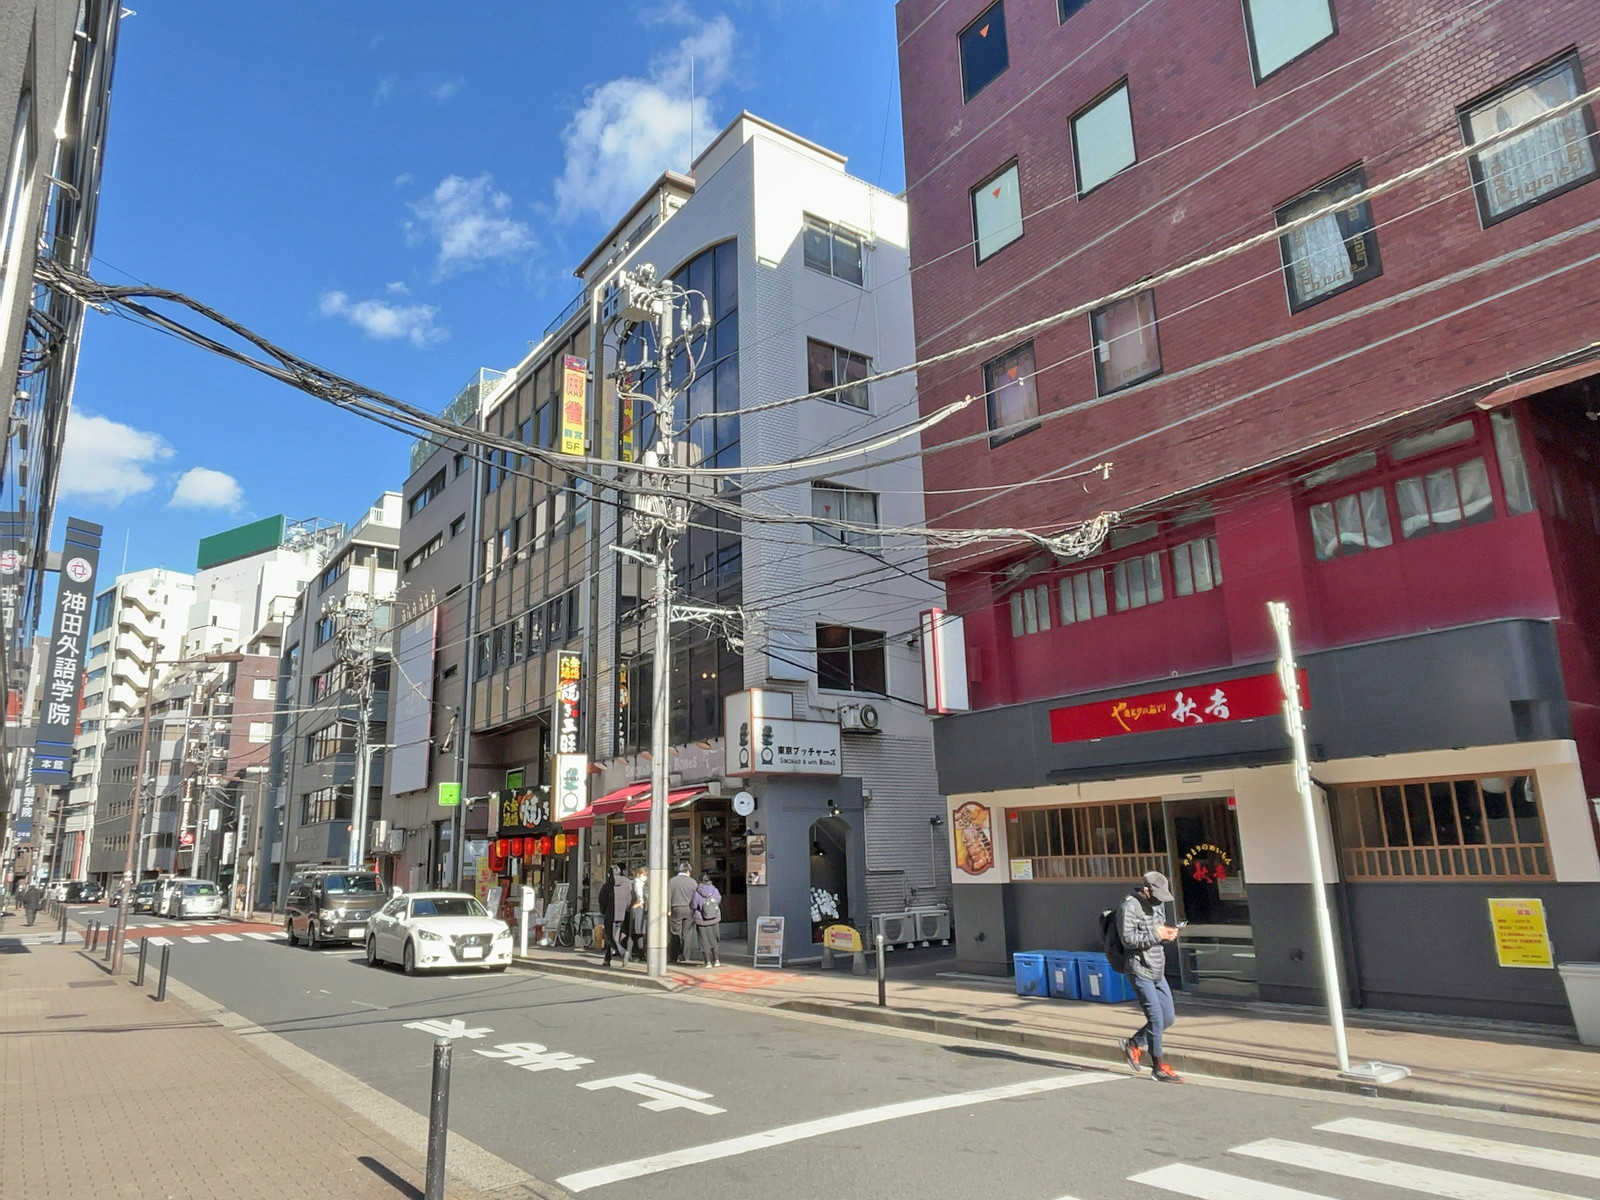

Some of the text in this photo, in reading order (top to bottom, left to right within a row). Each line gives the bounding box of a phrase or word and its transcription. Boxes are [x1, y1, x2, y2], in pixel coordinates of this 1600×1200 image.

[565, 373, 584, 425] 麻雀
[566, 441, 580, 450] 5F
[47, 590, 87, 726] 神田外語学院
[1171, 688, 1230, 723] 秋吉
[41, 759, 64, 770] 本館
[777, 745, 837, 757] 東京ブッチャーズ
[402, 1018, 728, 1116] 止まれ
